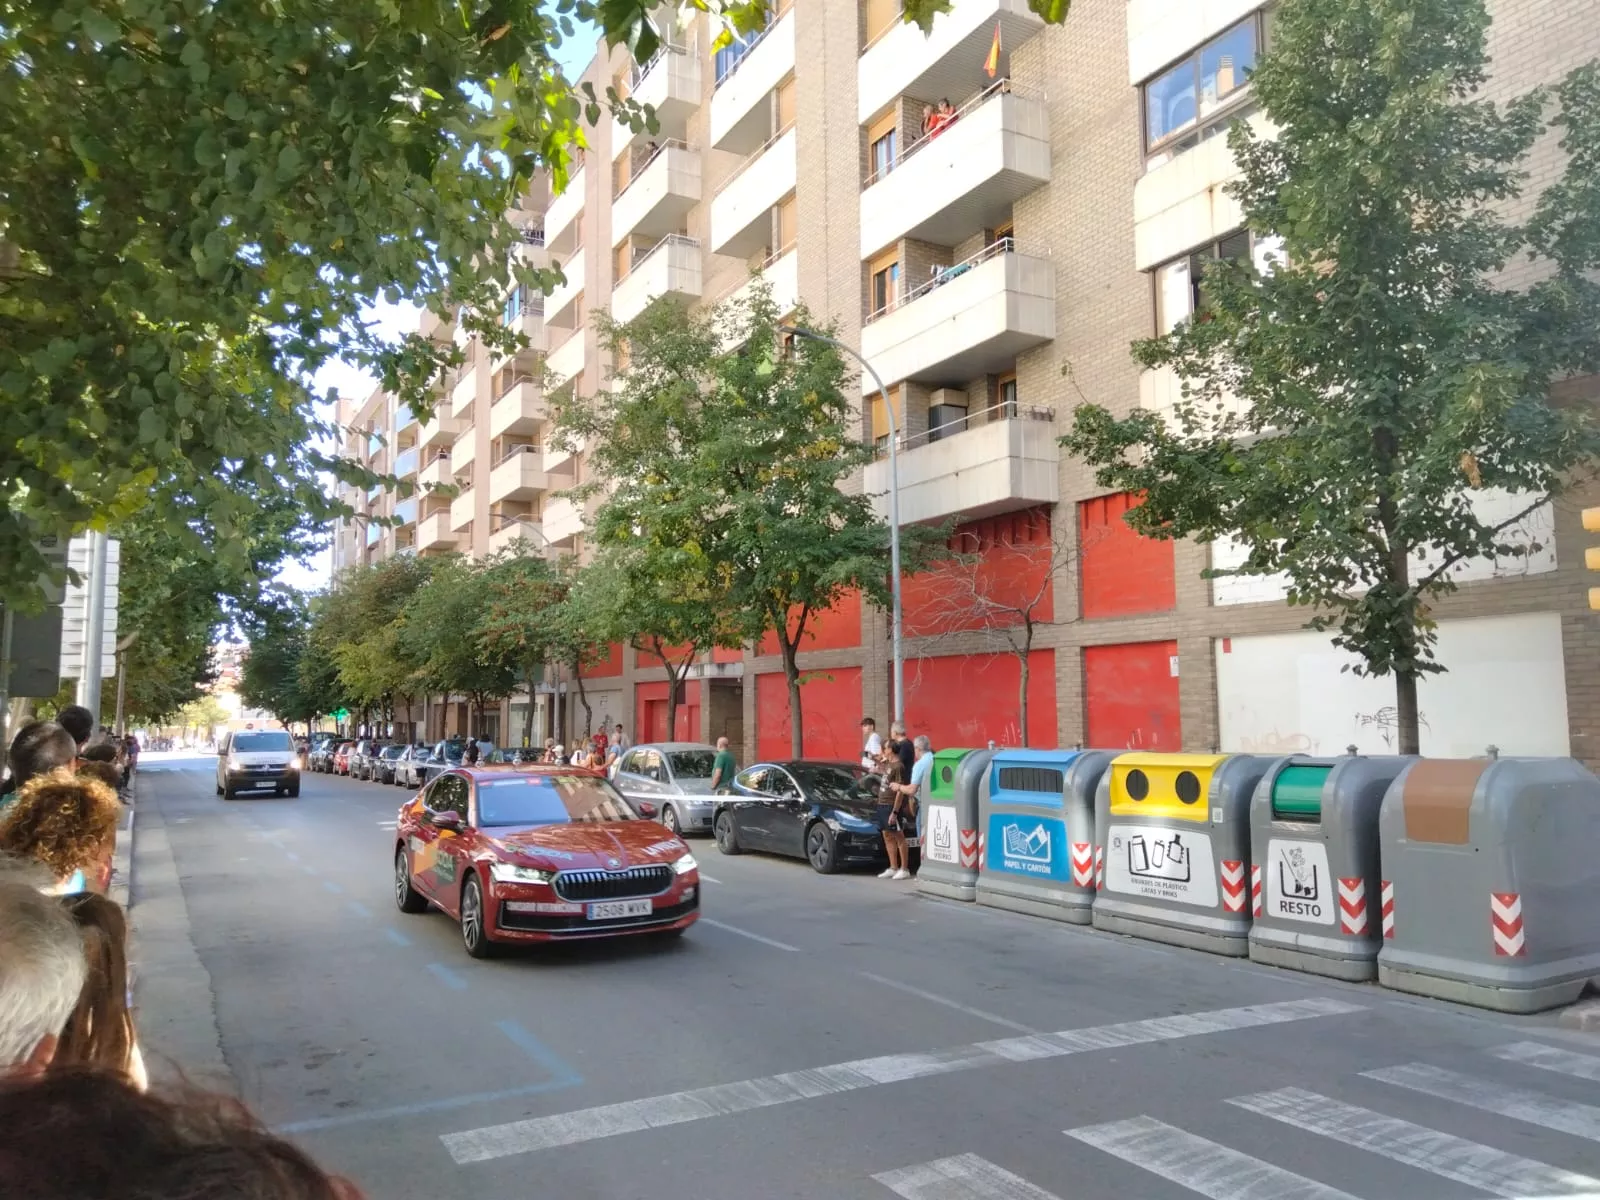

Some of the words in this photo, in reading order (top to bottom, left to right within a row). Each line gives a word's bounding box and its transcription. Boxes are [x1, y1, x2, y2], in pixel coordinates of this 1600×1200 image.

[1004, 859, 1021, 870] PAPEL
[1141, 887, 1156, 895] LATAS
[1163, 890, 1178, 898] BRIKS
[596, 903, 622, 917] 2508
[1280, 900, 1321, 917] RESTO
